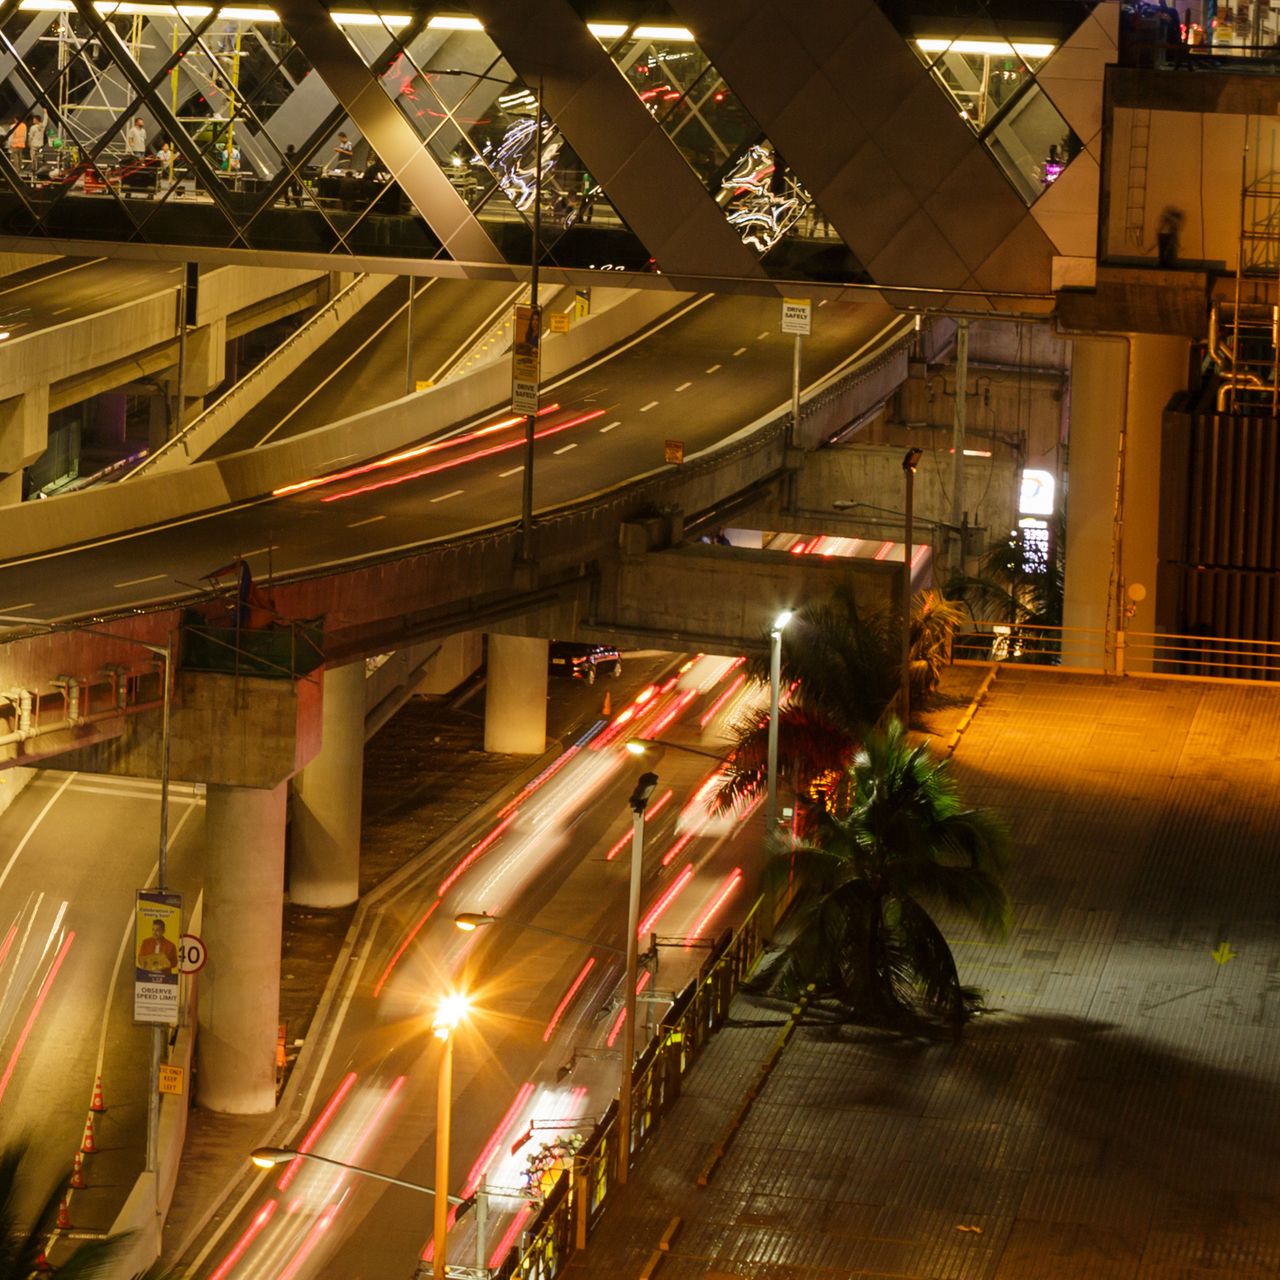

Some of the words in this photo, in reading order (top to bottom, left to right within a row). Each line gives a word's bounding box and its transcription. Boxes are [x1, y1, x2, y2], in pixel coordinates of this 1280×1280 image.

[786, 306, 806, 314] DRIVE
[785, 312, 808, 320] SAFELY
[178, 946, 200, 964] 40
[141, 987, 173, 995] OBSERVE
[136, 993, 158, 1001] SPEED
[159, 994, 178, 1002] LIMIT
